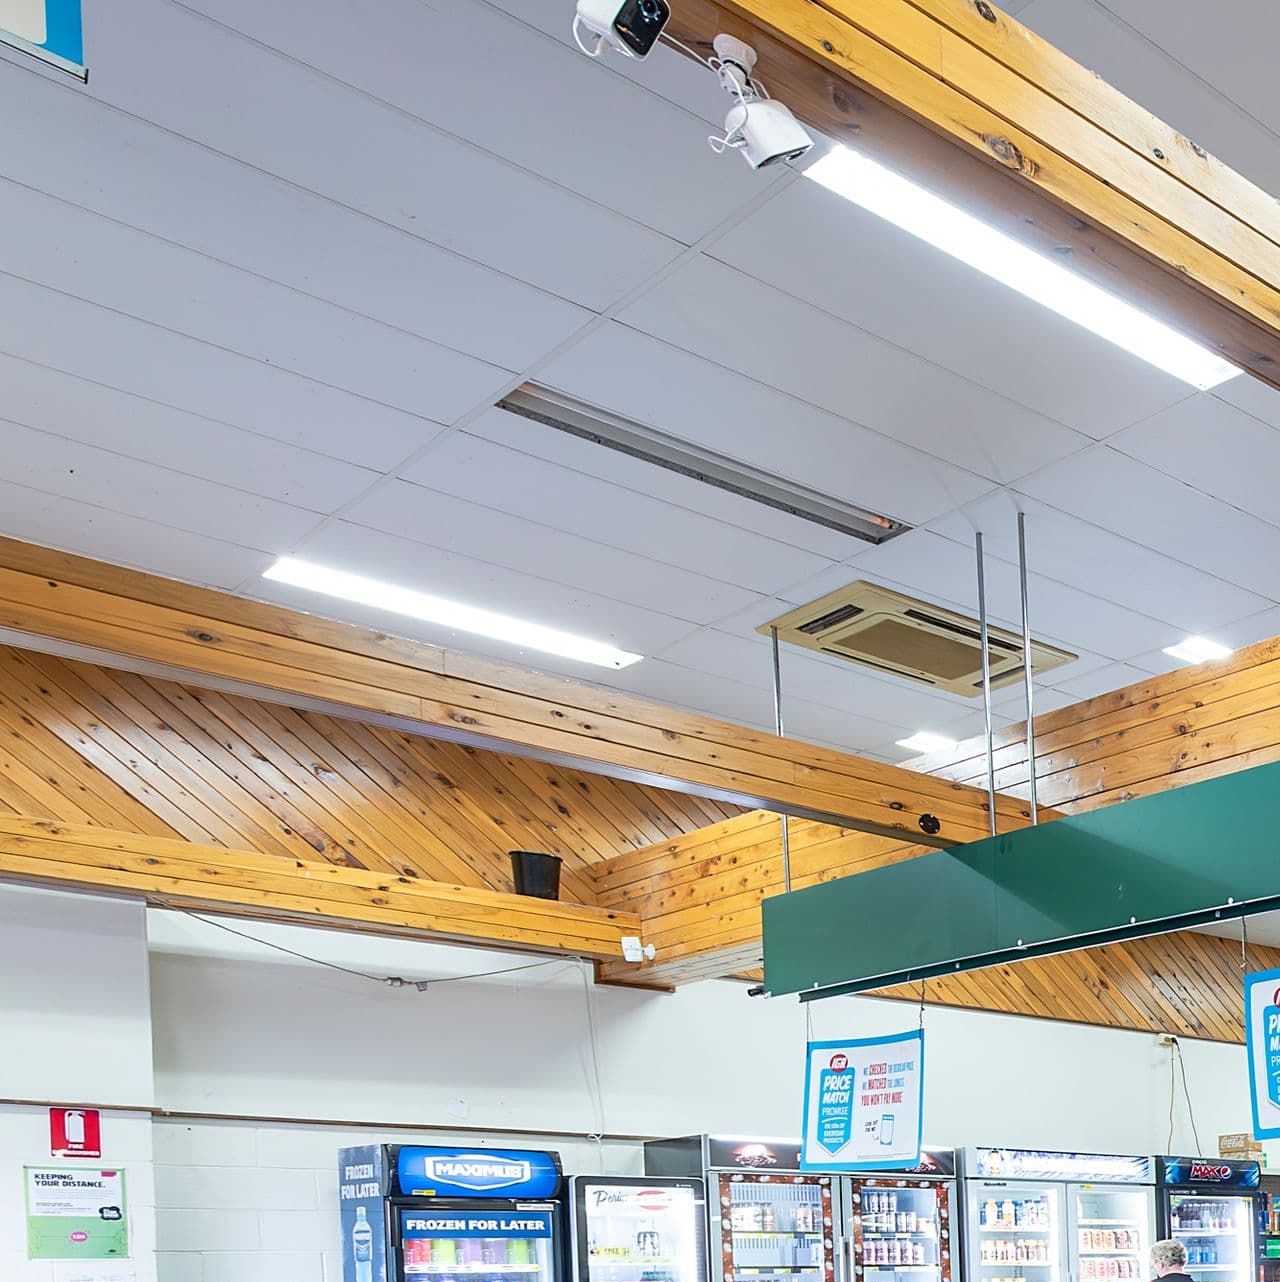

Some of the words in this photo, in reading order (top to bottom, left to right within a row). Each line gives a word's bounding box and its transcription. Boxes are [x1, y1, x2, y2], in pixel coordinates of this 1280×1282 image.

[869, 1063, 887, 1076] CHECKED
[823, 1074, 852, 1092] PRICE
[867, 1078, 887, 1091] MATCHED
[822, 1090, 850, 1105] MATCH
[821, 1106, 849, 1116] PROMISE
[345, 1163, 374, 1181] FROZEN
[435, 1161, 524, 1178] MAXIMUS
[1190, 1164, 1222, 1178] MAX
[341, 1184, 355, 1200] FOR
[355, 1182, 380, 1199] LATER
[406, 1219, 466, 1231] FROZEN
[468, 1220, 498, 1231] FOR
[500, 1220, 545, 1231] LATER
